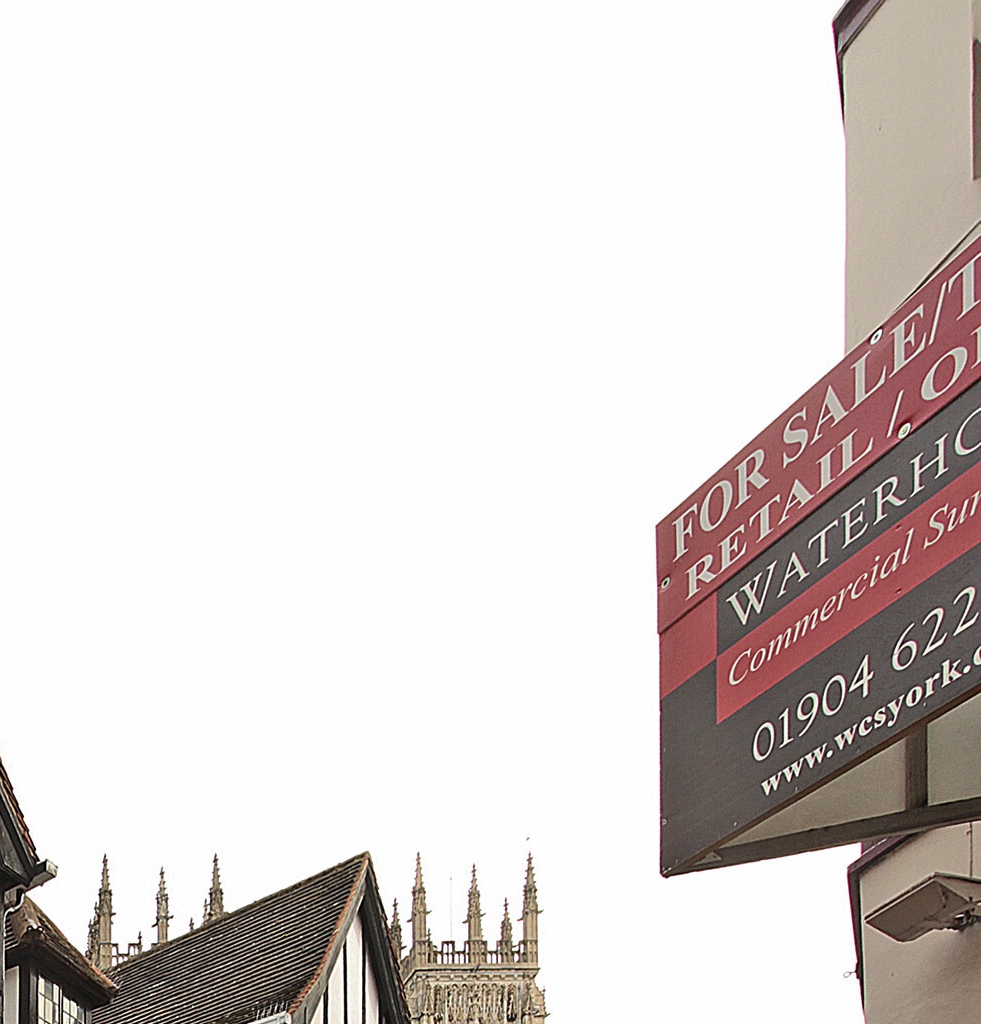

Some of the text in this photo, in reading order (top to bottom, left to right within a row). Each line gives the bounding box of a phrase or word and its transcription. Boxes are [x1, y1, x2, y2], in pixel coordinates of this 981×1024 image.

[672, 449, 770, 563] FOR
[685, 429, 874, 601] RETAIL
[728, 527, 914, 686] Commercial
[751, 585, 980, 763] 01904 622
